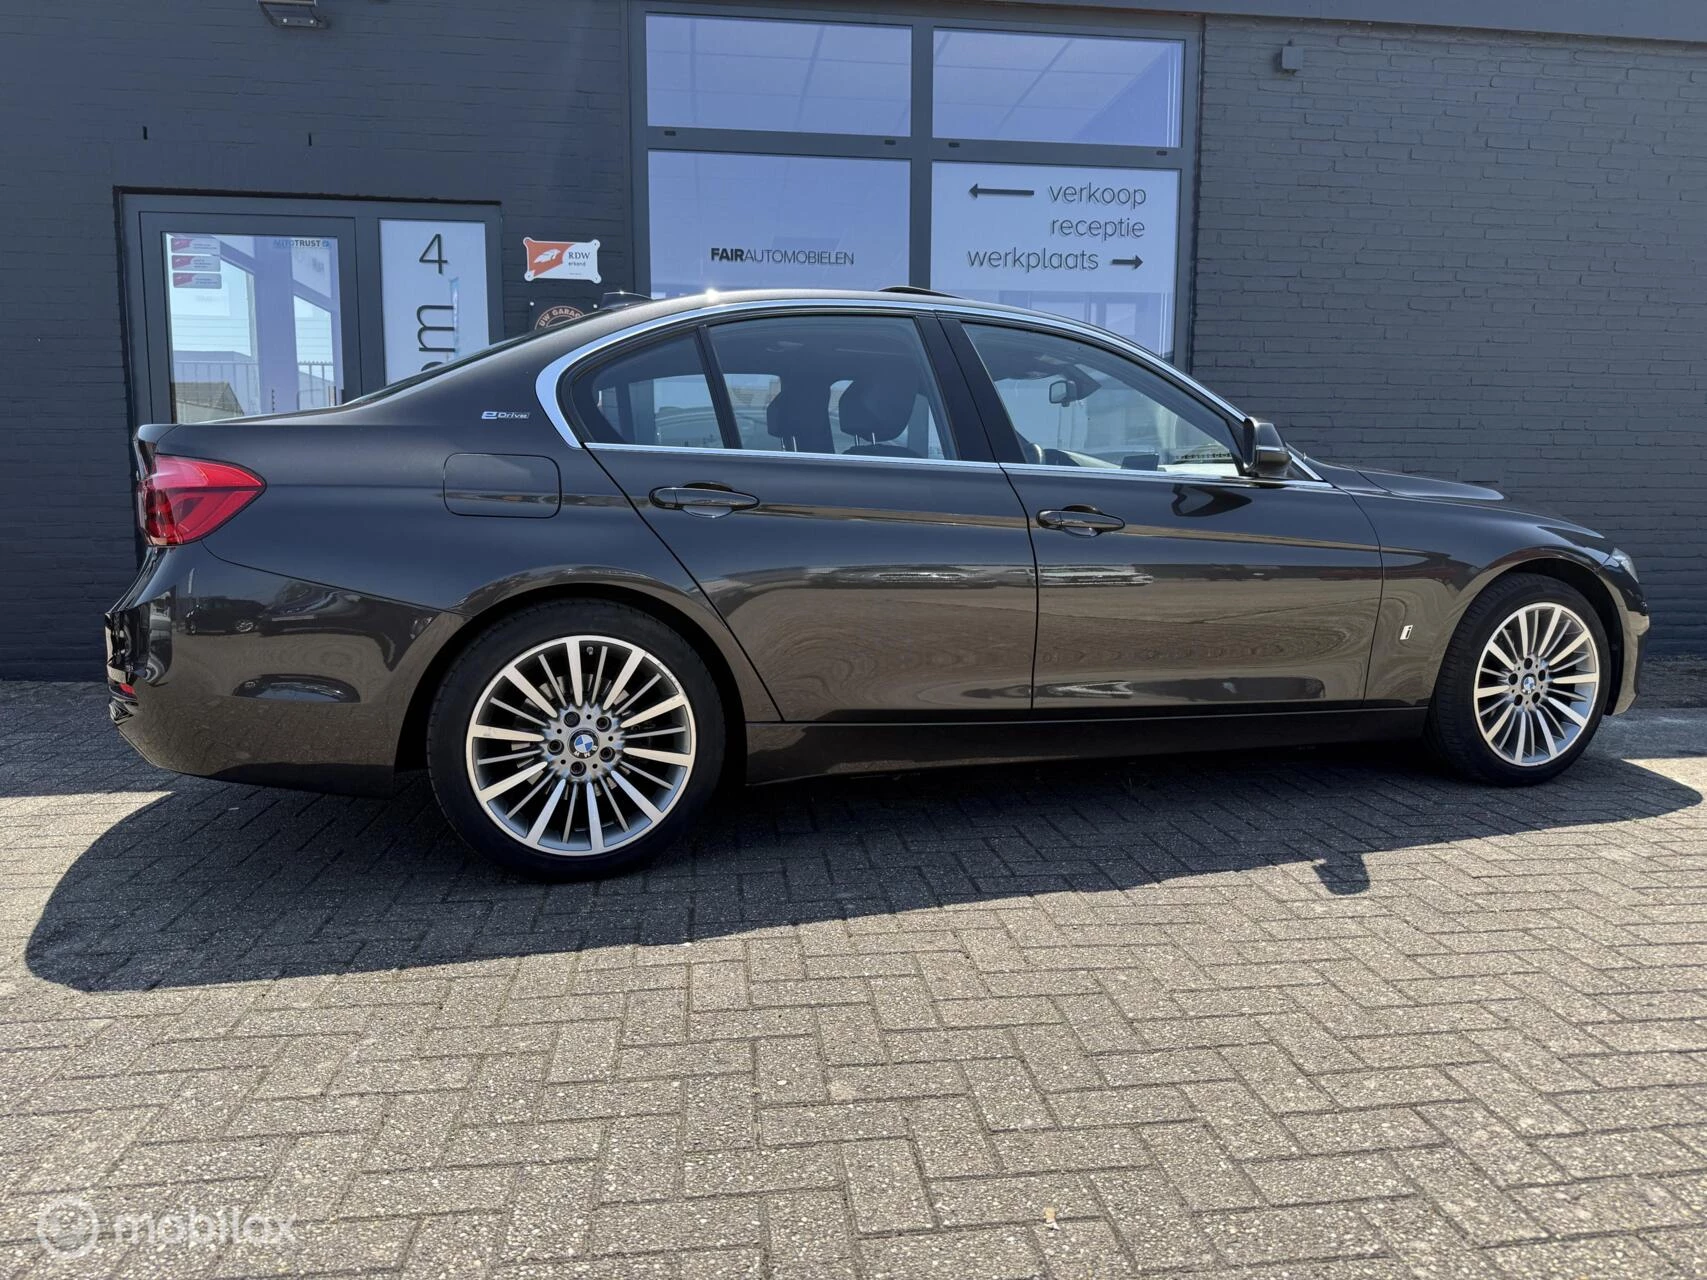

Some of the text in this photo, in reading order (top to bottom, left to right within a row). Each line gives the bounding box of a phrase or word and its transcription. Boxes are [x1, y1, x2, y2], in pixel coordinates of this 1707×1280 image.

[1049, 182, 1147, 210] verkoop
[1051, 217, 1145, 242] receptie
[273, 239, 321, 248] AUTOTRUST
[418, 233, 448, 275] 4
[567, 251, 591, 260] RDW
[710, 247, 855, 266] FAIRAUTOMOBIELEN
[967, 246, 1100, 273] werkplaats
[551, 308, 583, 319] GARAG
